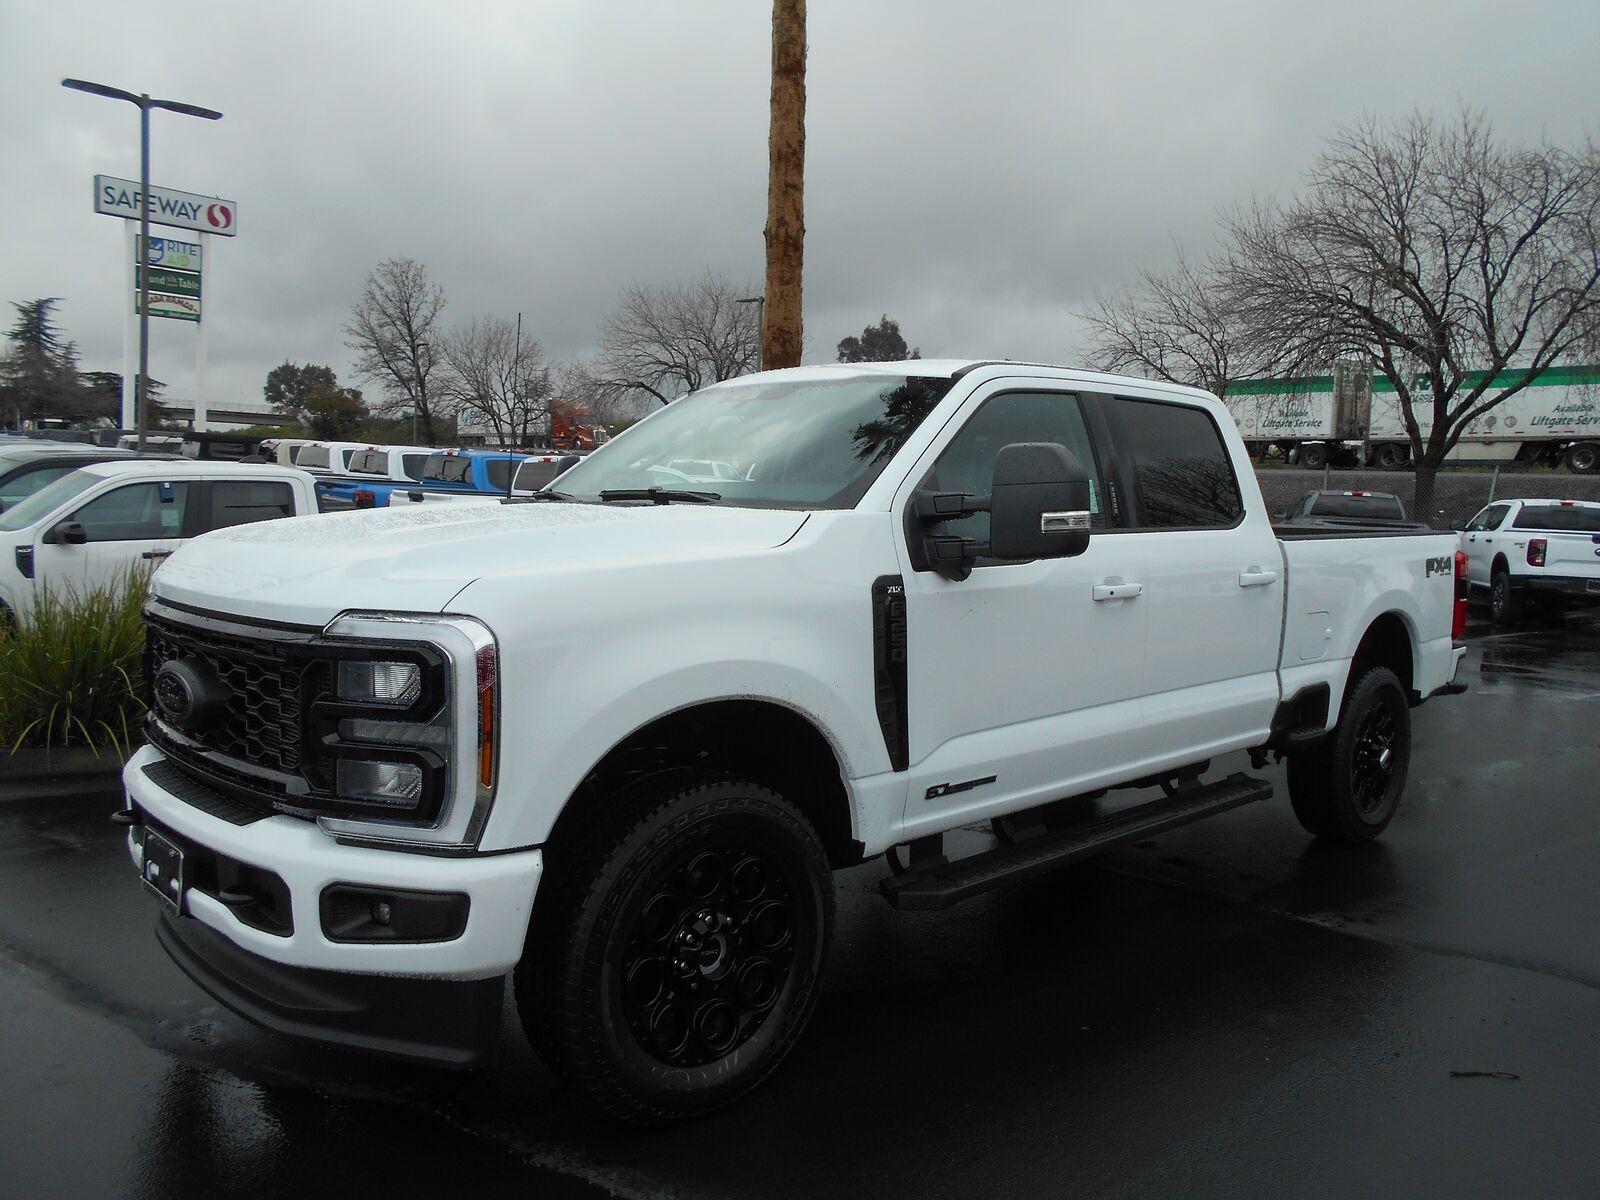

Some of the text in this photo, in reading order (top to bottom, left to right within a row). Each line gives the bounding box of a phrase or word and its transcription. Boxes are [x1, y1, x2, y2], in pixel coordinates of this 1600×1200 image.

[104, 186, 201, 220] SAFEWAY
[167, 241, 197, 256] RITE
[167, 254, 189, 266] AID
[178, 277, 199, 290] Table
[1552, 404, 1594, 413] Available
[1262, 418, 1323, 429] Liftgate Service
[1531, 415, 1573, 428] Liftgate
[1426, 557, 1451, 578] FX4
